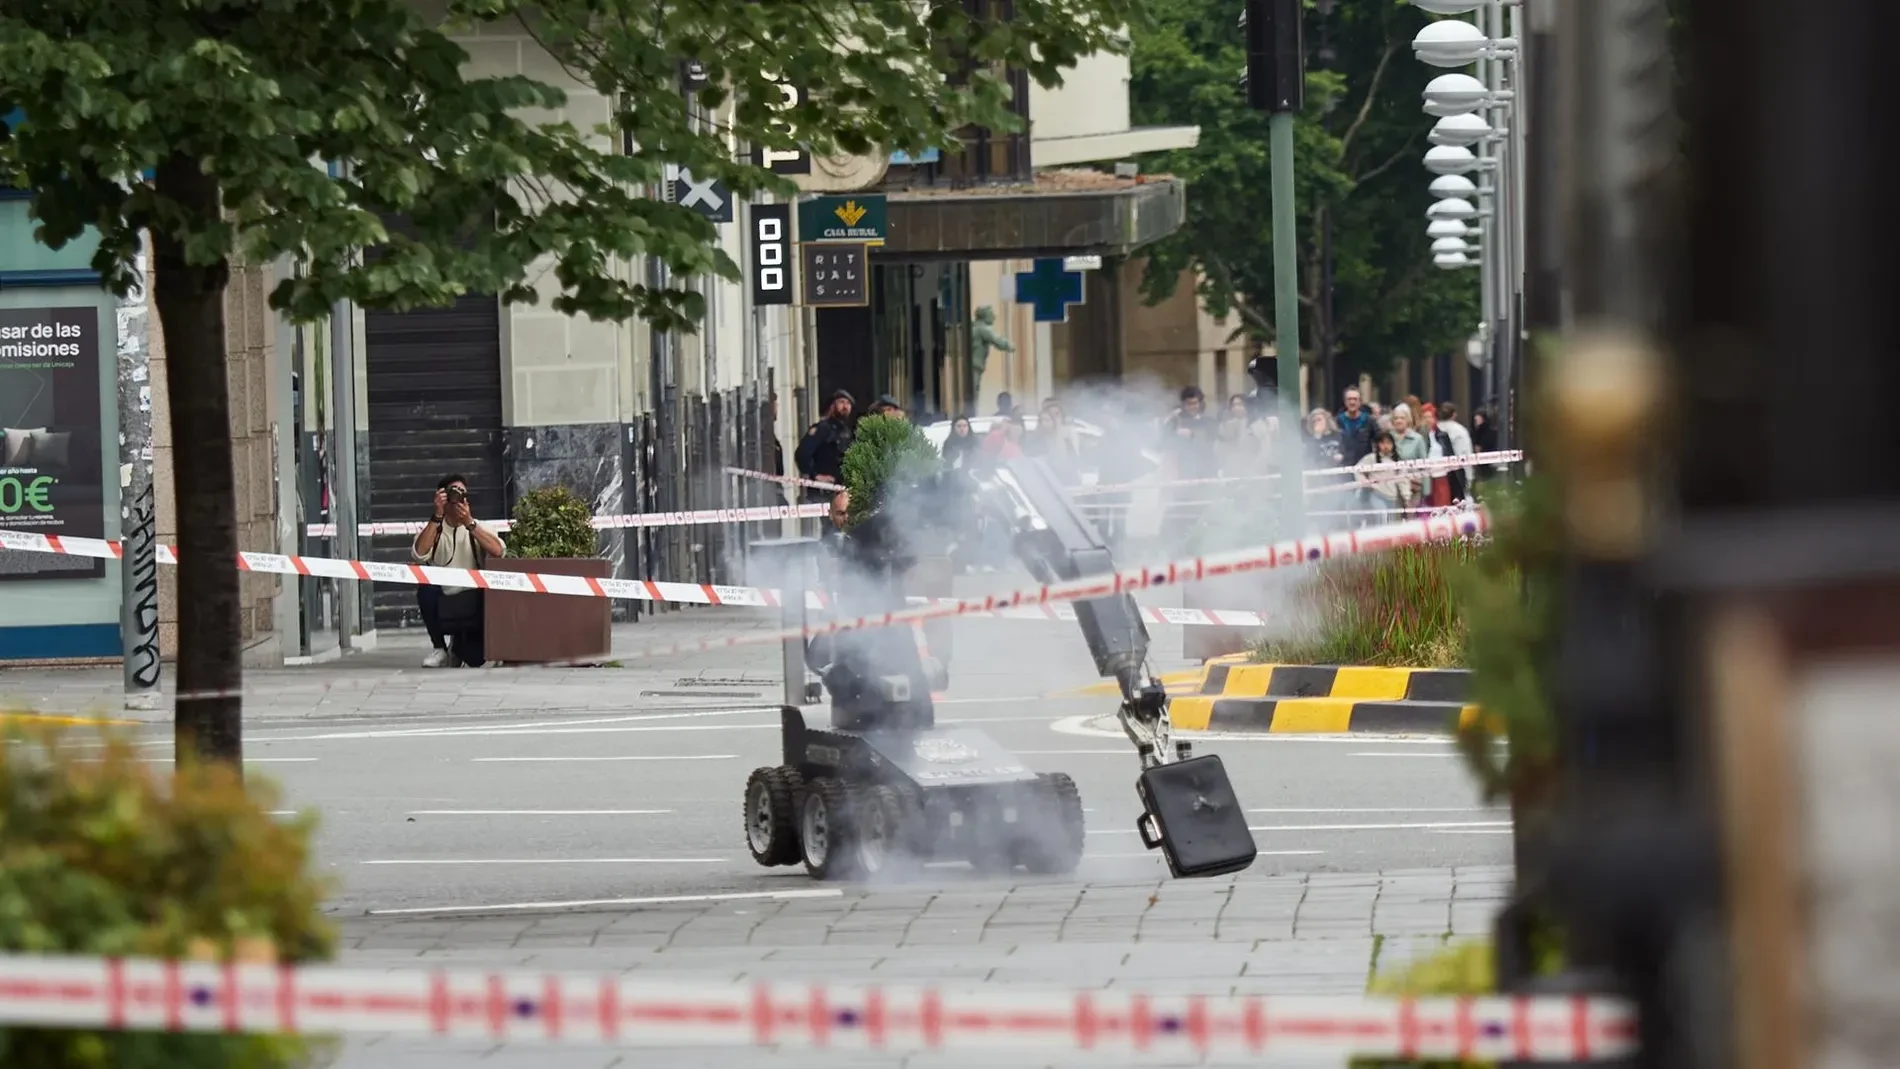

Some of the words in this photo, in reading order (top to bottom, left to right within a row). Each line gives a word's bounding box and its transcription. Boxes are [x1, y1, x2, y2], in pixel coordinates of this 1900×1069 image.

[847, 227, 878, 237] RURAL
[0, 326, 28, 339] sar
[31, 323, 53, 338] de
[56, 322, 81, 338] las
[0, 341, 79, 357] misiones
